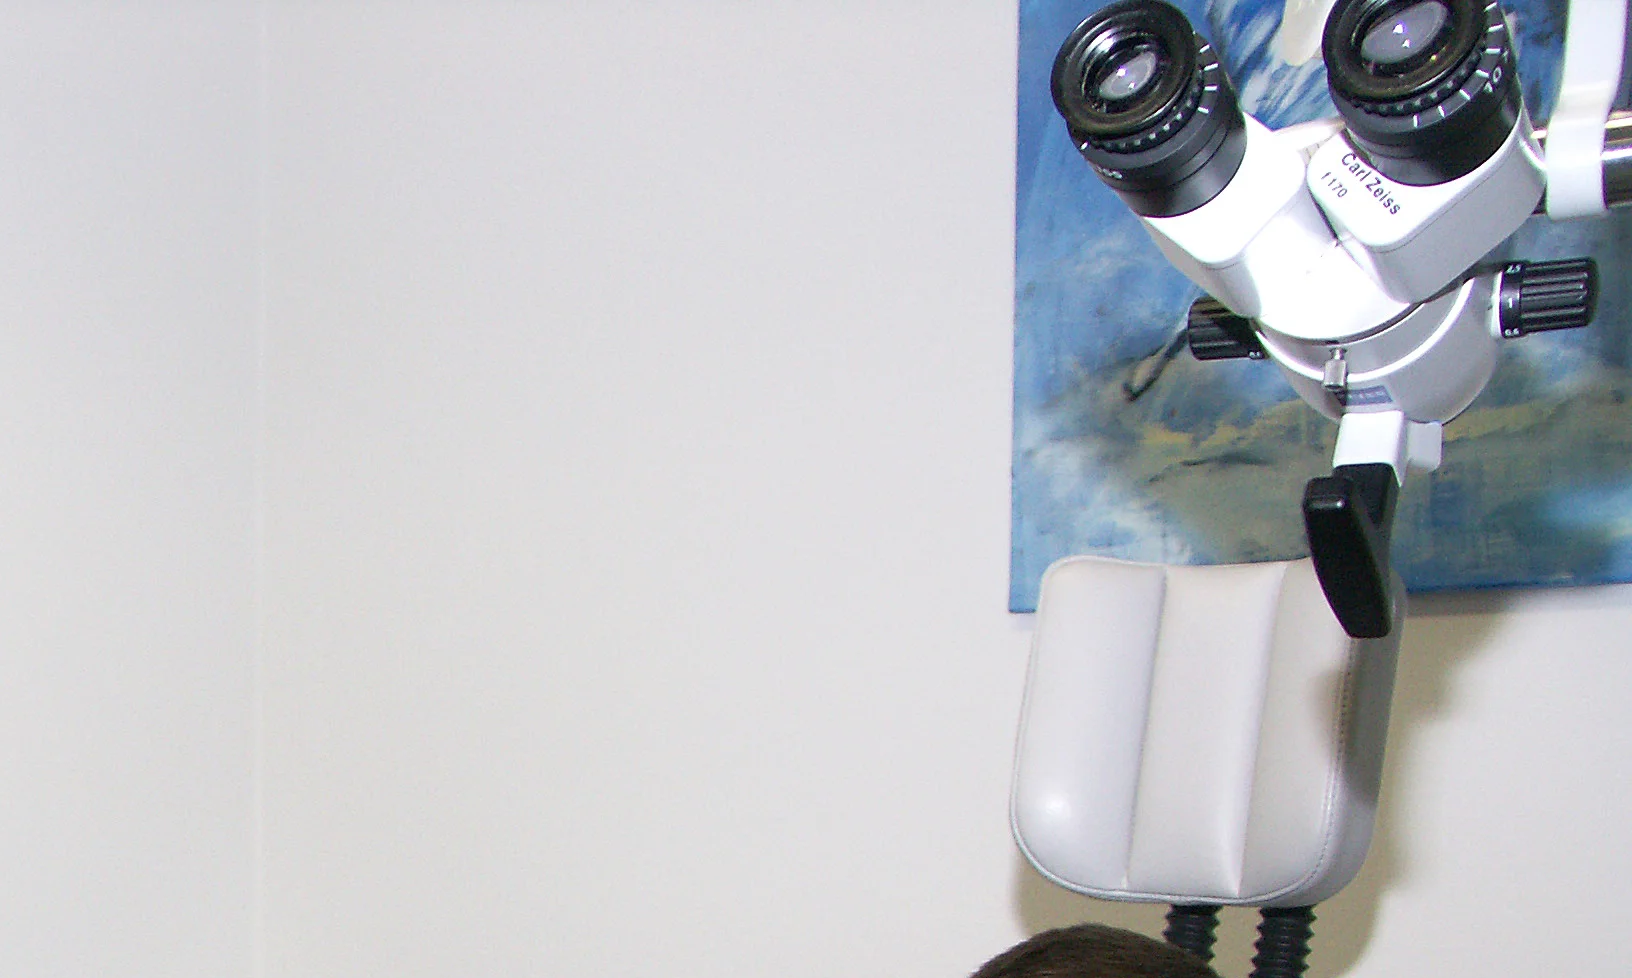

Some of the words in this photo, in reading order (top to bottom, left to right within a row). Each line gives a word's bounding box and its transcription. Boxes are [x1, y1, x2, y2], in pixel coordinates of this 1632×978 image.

[1327, 178, 1349, 198] 170
[1341, 152, 1373, 182] Carl
[1365, 177, 1402, 216] Zeiss
